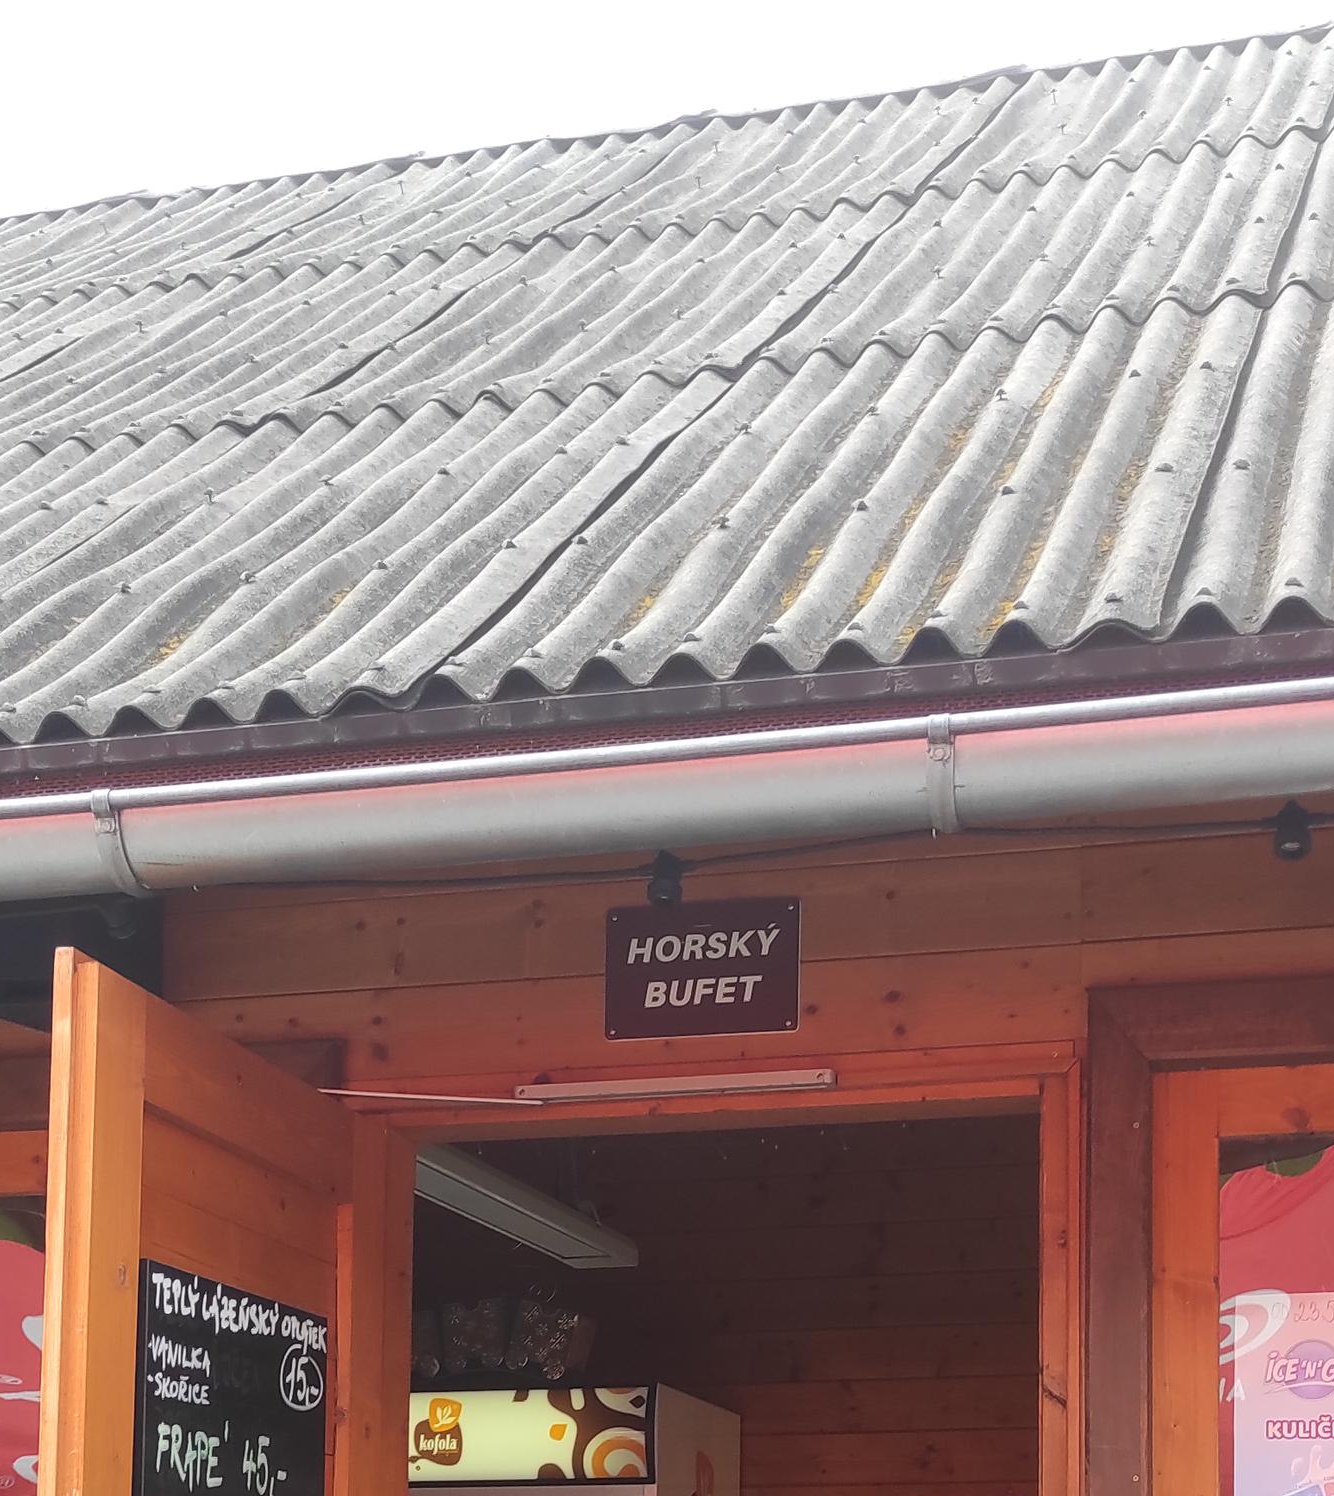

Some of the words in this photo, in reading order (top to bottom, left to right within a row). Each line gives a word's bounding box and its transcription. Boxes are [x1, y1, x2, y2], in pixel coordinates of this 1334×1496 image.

[627, 922, 780, 964] HORSKÝ
[643, 974, 763, 1008] BUFET
[152, 1273, 200, 1318] TEPLÝ
[155, 1420, 229, 1492] FRAPÉ
[418, 1433, 458, 1456] kofola
